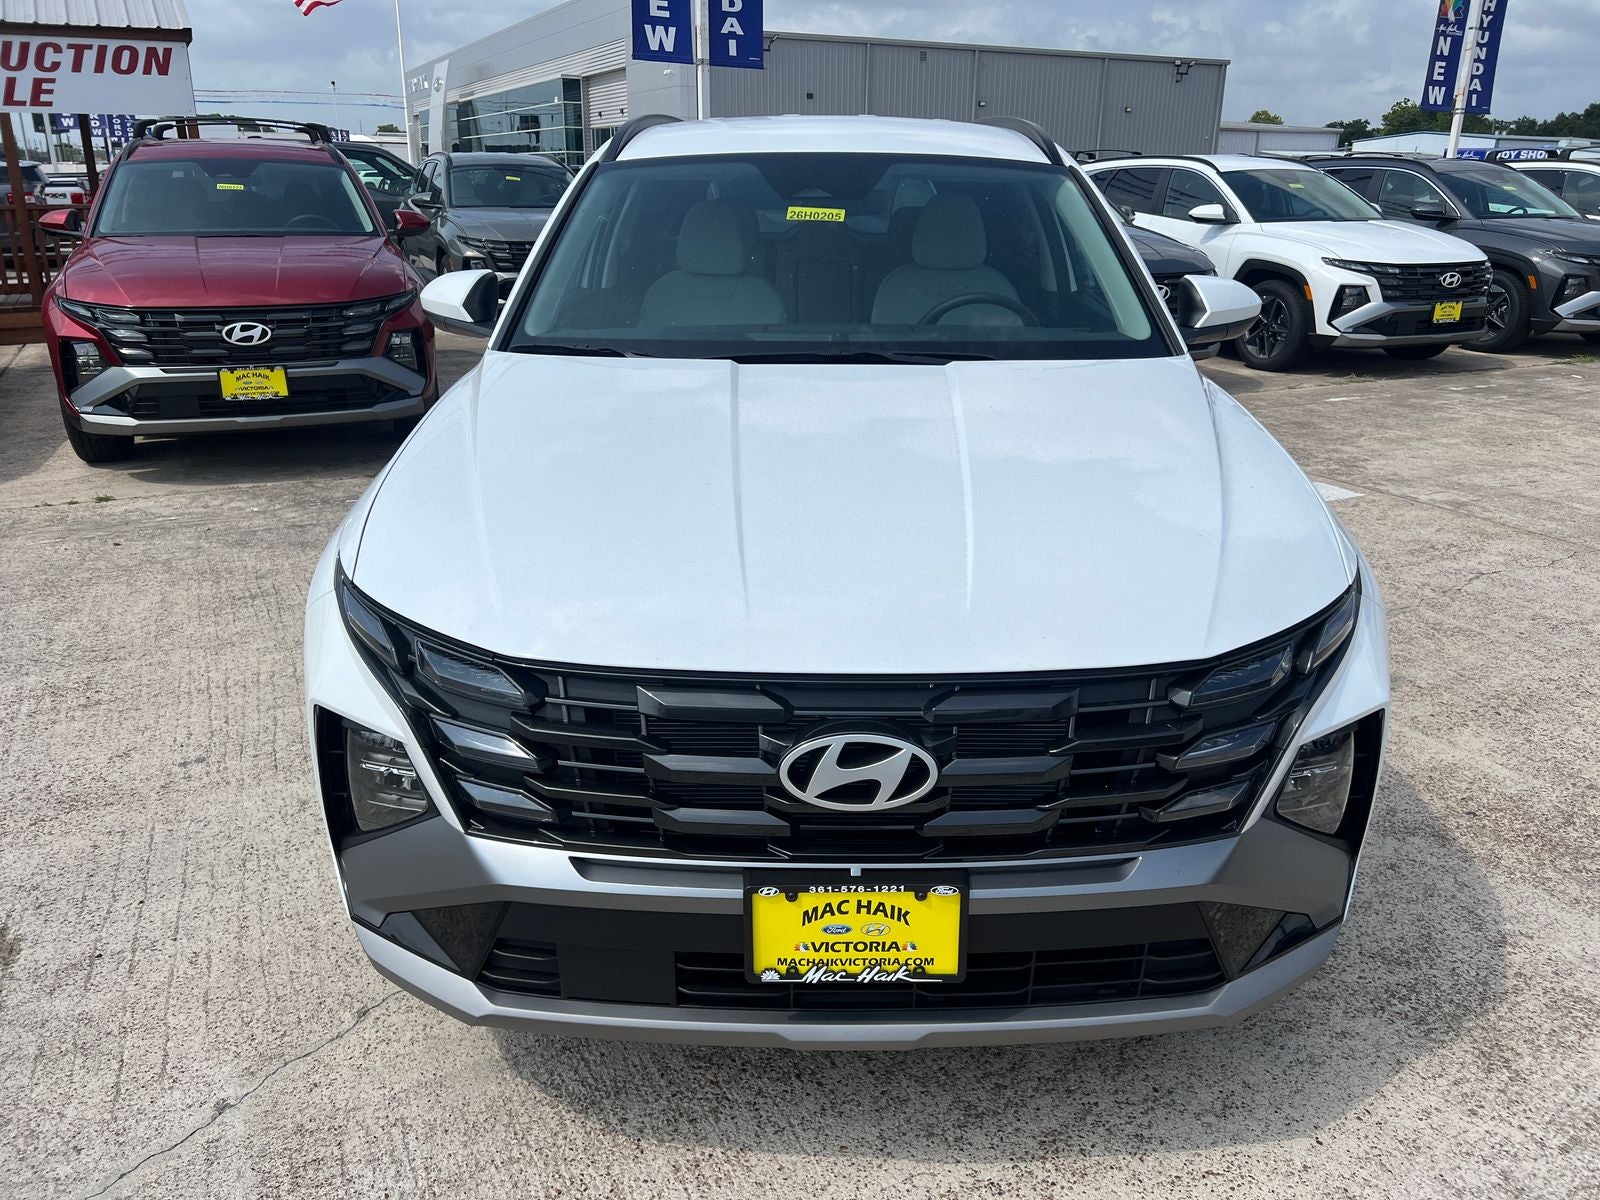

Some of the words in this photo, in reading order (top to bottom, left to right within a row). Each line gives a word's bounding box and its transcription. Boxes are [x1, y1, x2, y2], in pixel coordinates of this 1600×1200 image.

[1428, 36, 1451, 105] NEW
[789, 210, 841, 220] 26H0205
[808, 885, 906, 893] 361-576-1221
[801, 900, 850, 927] MAC
[856, 899, 911, 927] HAIK
[810, 941, 901, 953] VICTORIA
[777, 957, 935, 967] MACHAIKVICTORIA.COM
[801, 965, 855, 984] Mac
[856, 965, 915, 984] Haik
